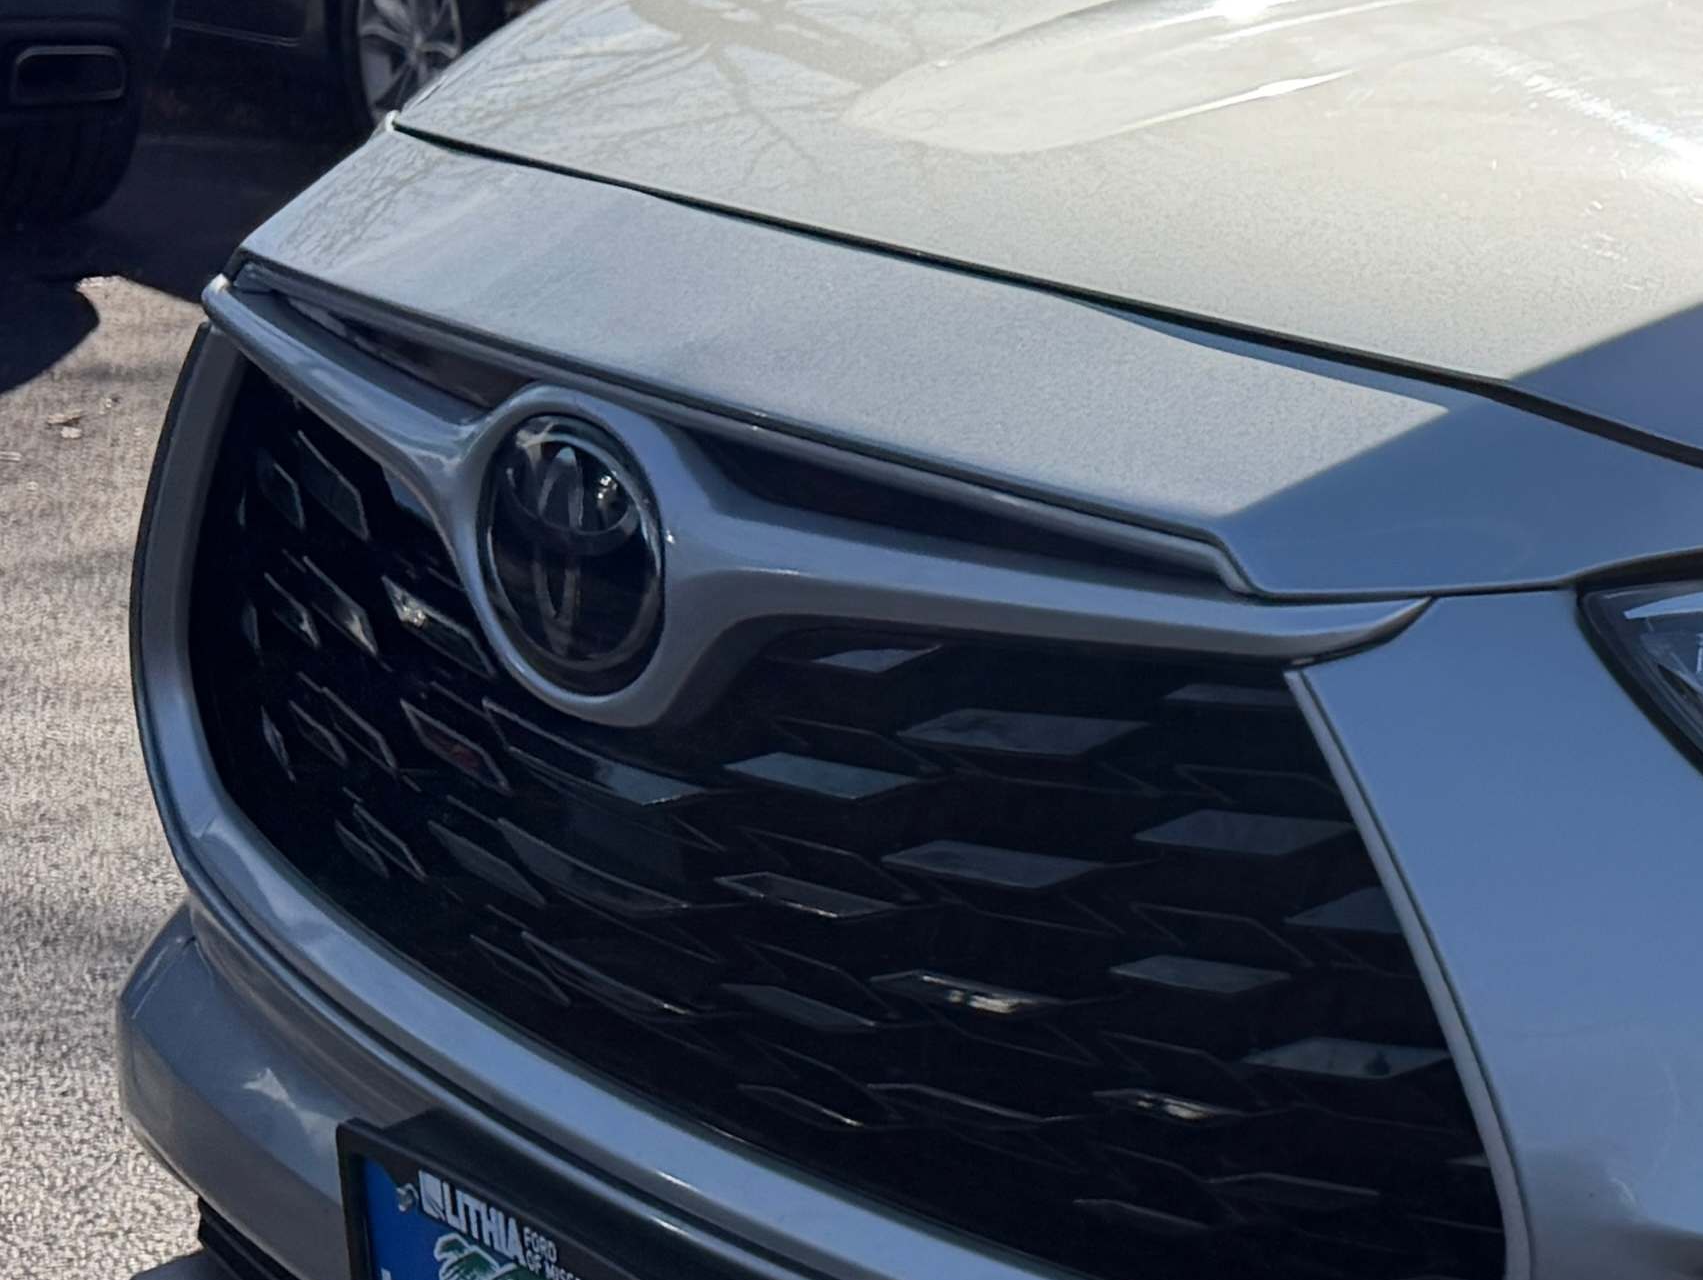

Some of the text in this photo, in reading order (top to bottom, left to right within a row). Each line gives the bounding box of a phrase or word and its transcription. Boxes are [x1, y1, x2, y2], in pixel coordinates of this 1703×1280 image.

[443, 1180, 527, 1267] LITHIA
[522, 1226, 557, 1263] FORD
[525, 1249, 542, 1274] OF
